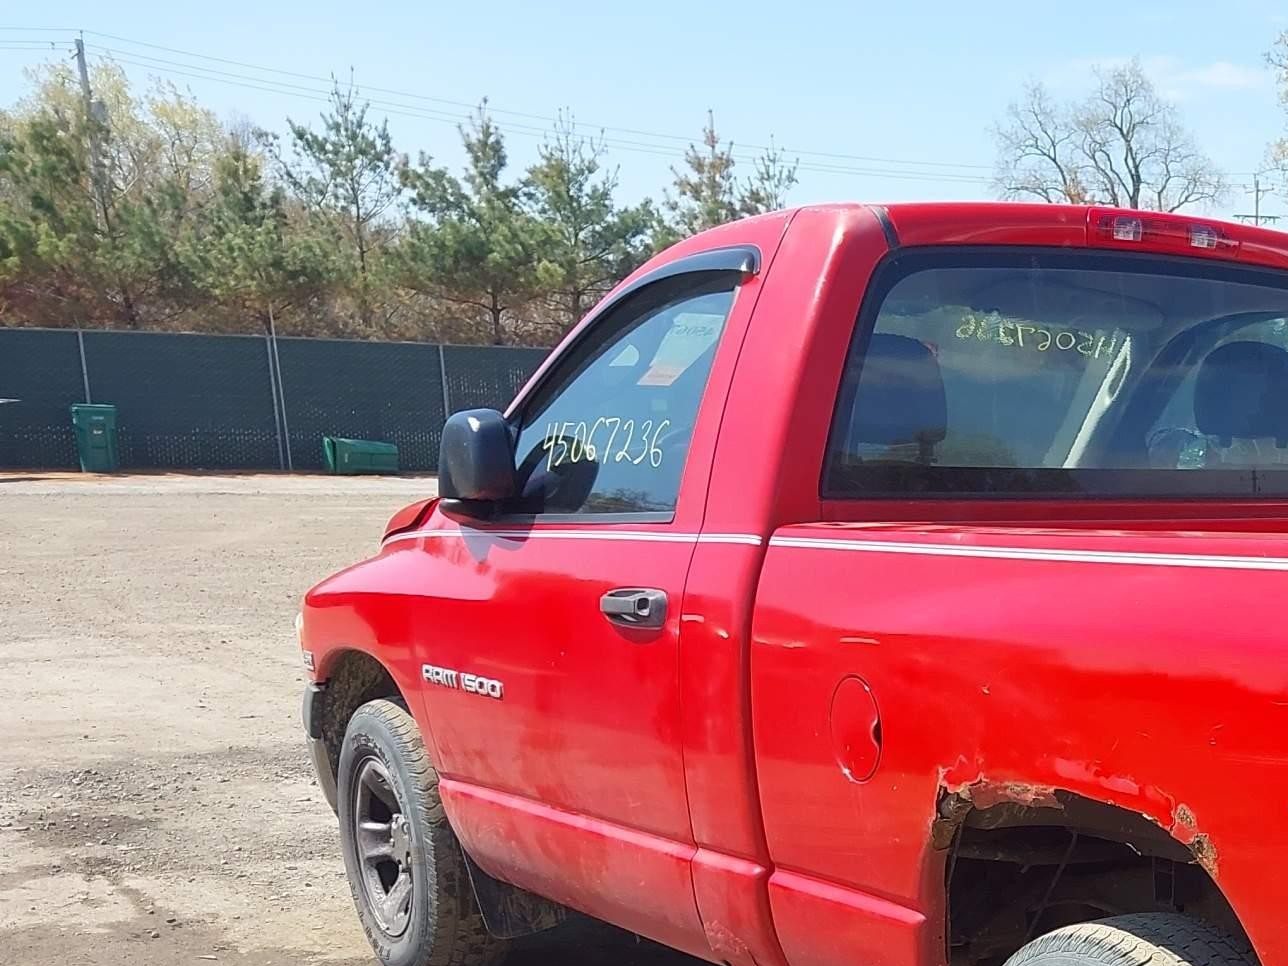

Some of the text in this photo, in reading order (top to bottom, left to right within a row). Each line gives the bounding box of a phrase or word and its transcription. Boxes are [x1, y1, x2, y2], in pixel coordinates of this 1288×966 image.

[543, 416, 670, 472] 45067236
[422, 663, 504, 700] RAM 1500
